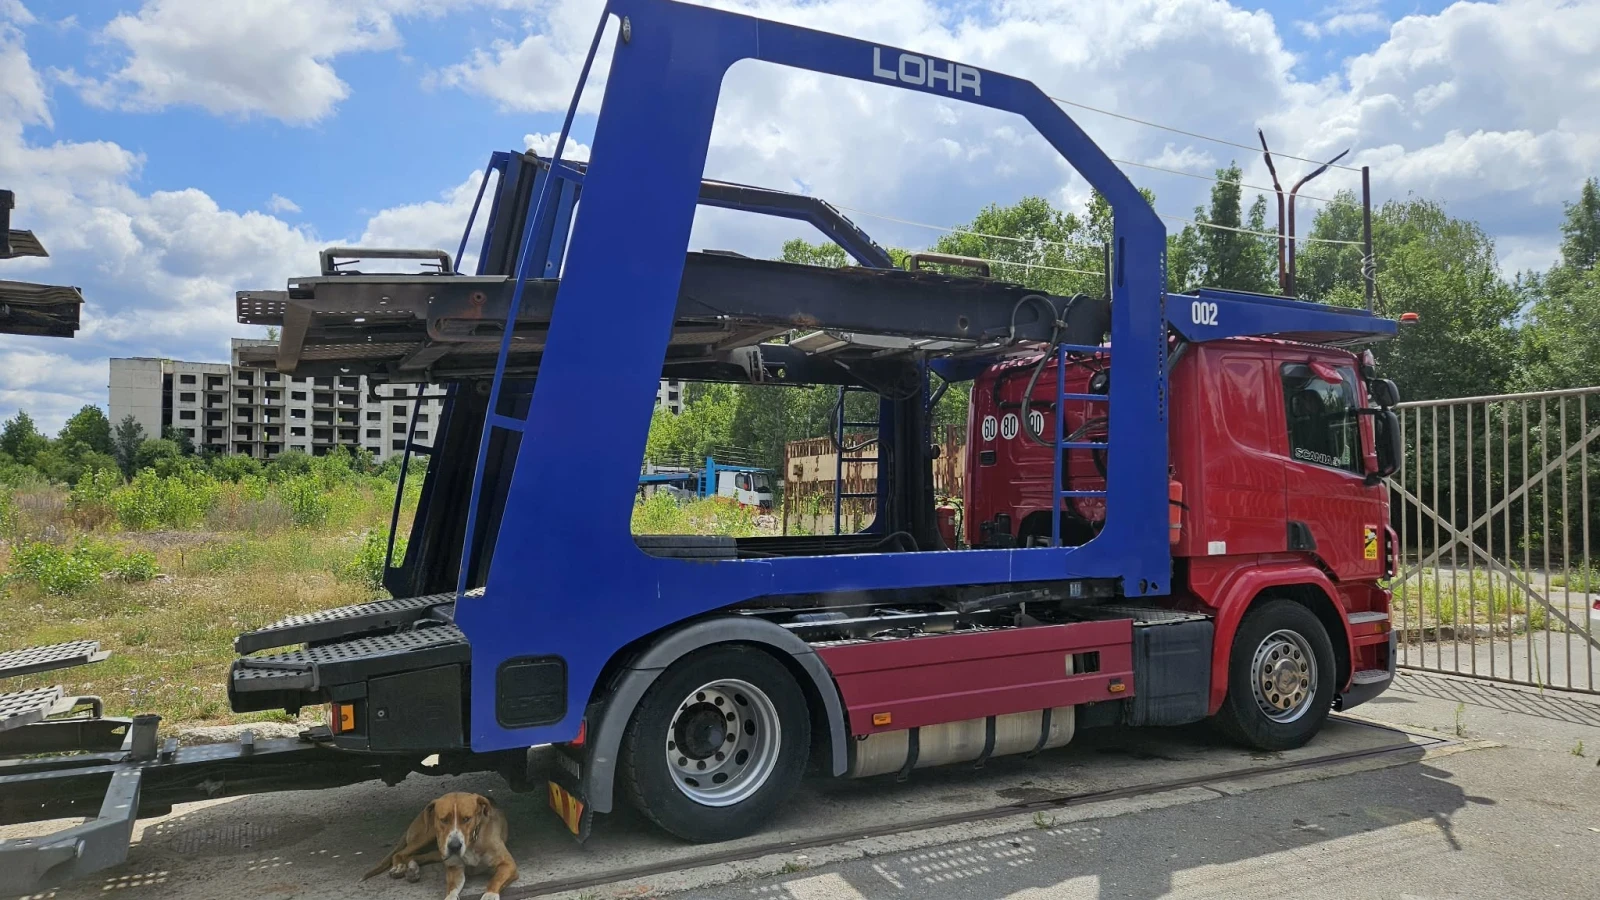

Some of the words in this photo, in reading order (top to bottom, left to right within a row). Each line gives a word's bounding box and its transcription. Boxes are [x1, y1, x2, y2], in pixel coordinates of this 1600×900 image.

[873, 46, 982, 97] LOHR
[1191, 301, 1218, 326] 002
[984, 418, 995, 438] 60
[1003, 415, 1016, 436] 80
[1294, 447, 1333, 466] SCANIA
